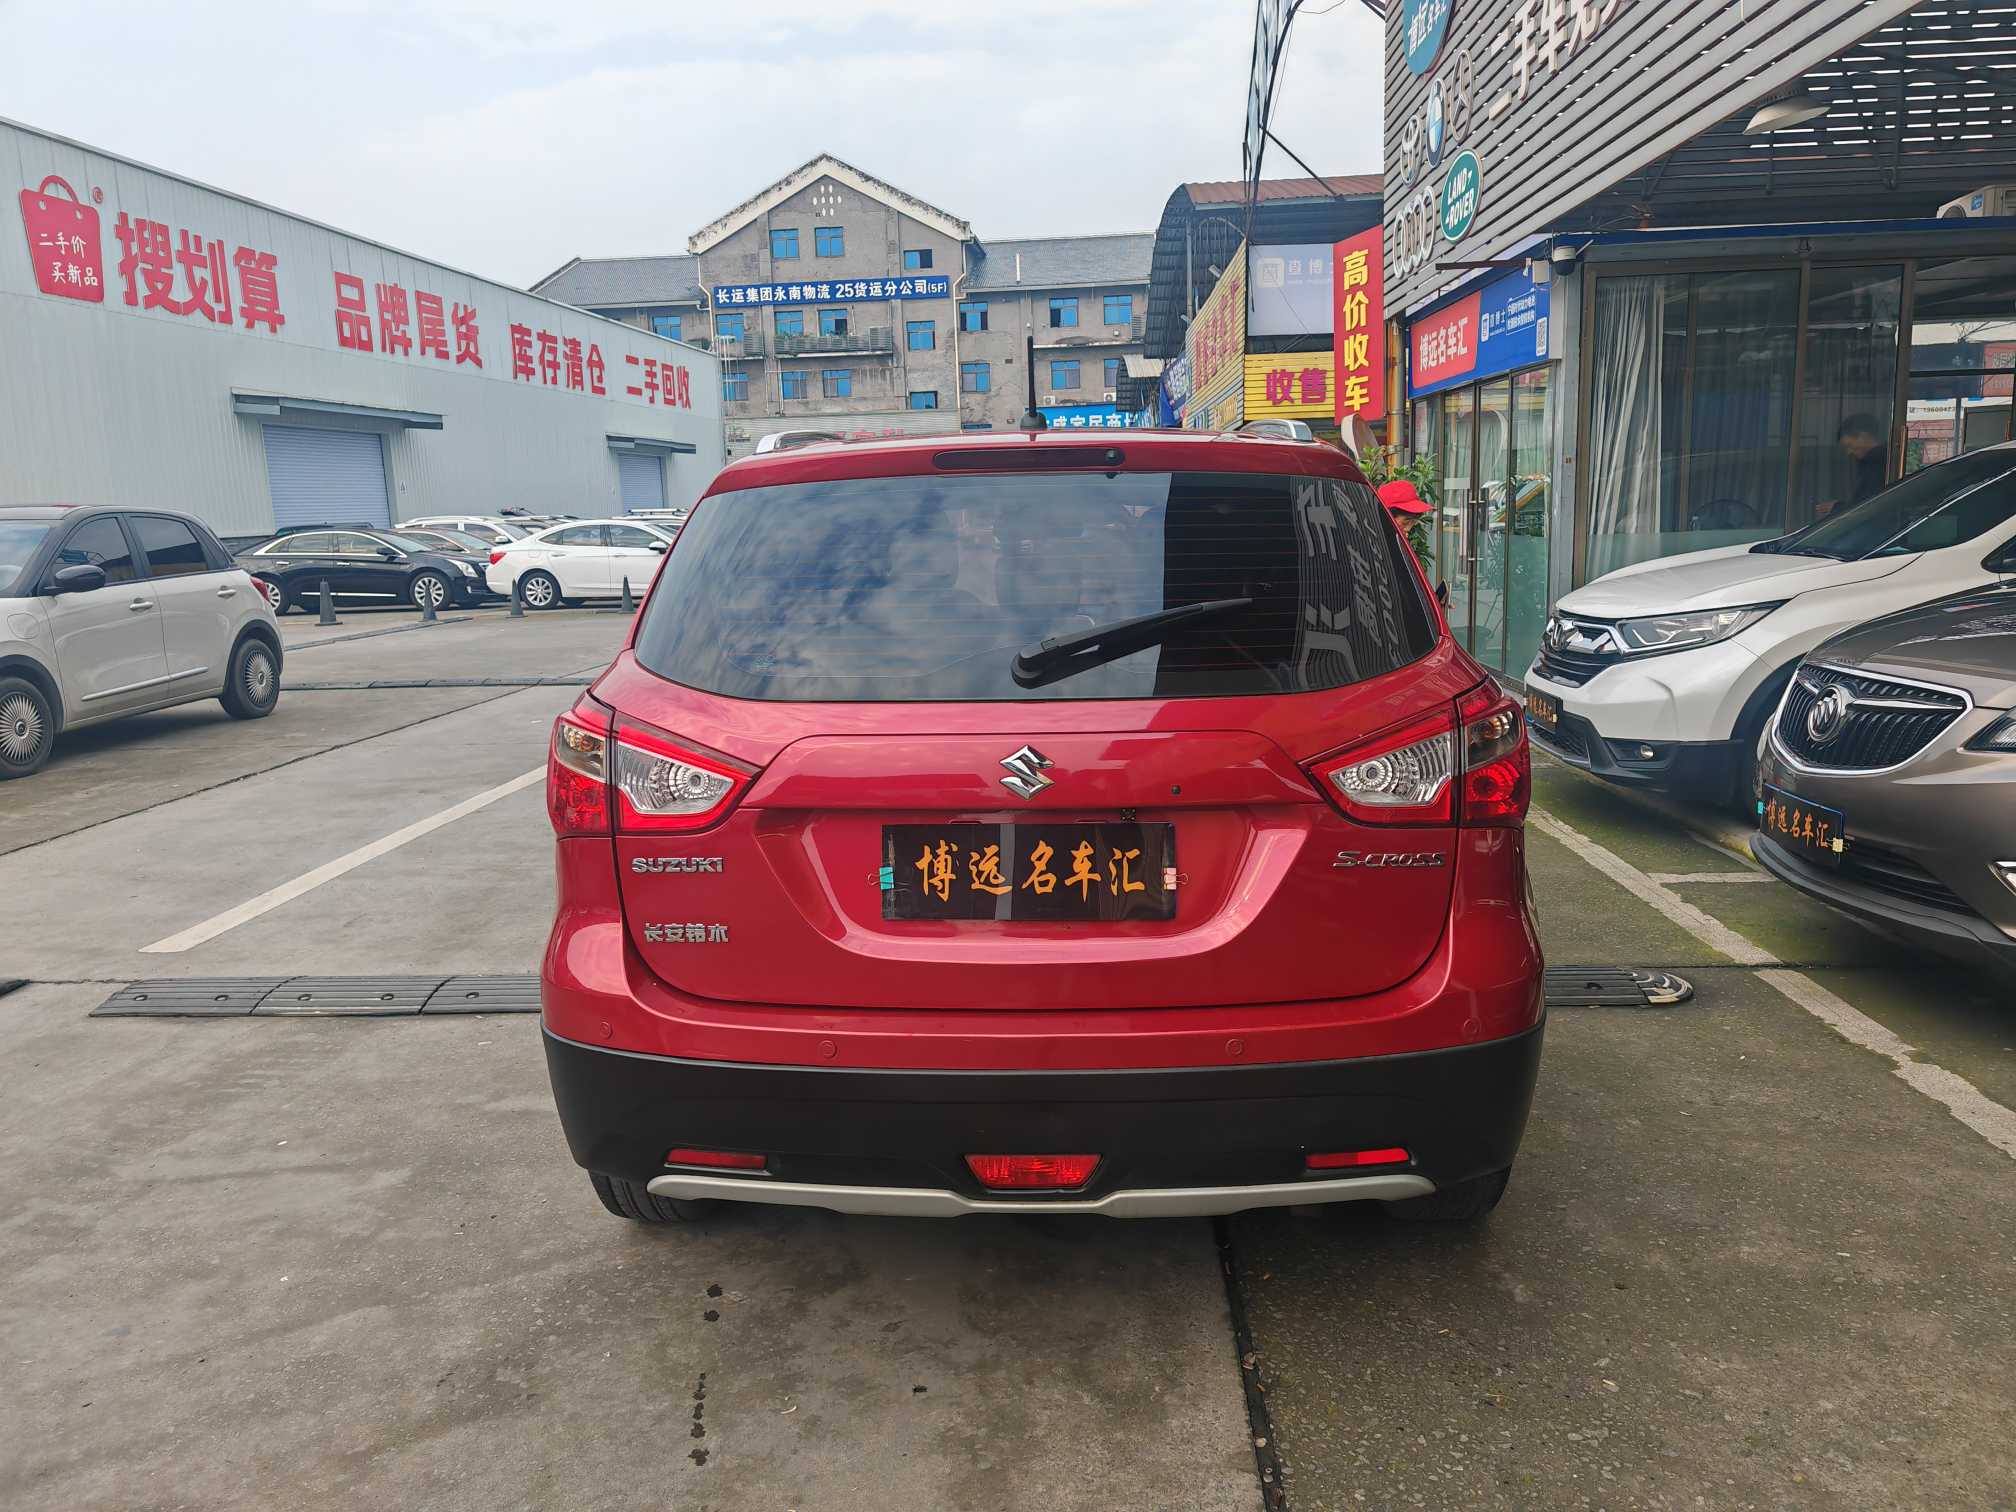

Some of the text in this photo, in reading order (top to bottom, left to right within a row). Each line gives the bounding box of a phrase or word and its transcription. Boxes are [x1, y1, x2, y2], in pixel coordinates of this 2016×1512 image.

[1448, 167, 1468, 206] LAND
[1448, 187, 1475, 230] ROVER
[39, 231, 87, 259] 二手价
[52, 261, 98, 288] 买新品
[114, 211, 692, 410] 搜划算 品牌尾货 库存清仓 二手回收
[716, 285, 831, 304] 长运集团永南物流
[1342, 248, 1370, 412] 高价收车
[1419, 316, 1468, 372] 博远名车汇
[1265, 368, 1327, 405] 收售
[1766, 796, 1830, 848] 博远名车汇
[631, 857, 724, 873] SUZUKI
[915, 839, 1146, 903] 博远名车汇
[1333, 850, 1446, 869] S-CROSS
[644, 923, 729, 943] 长安铃木
